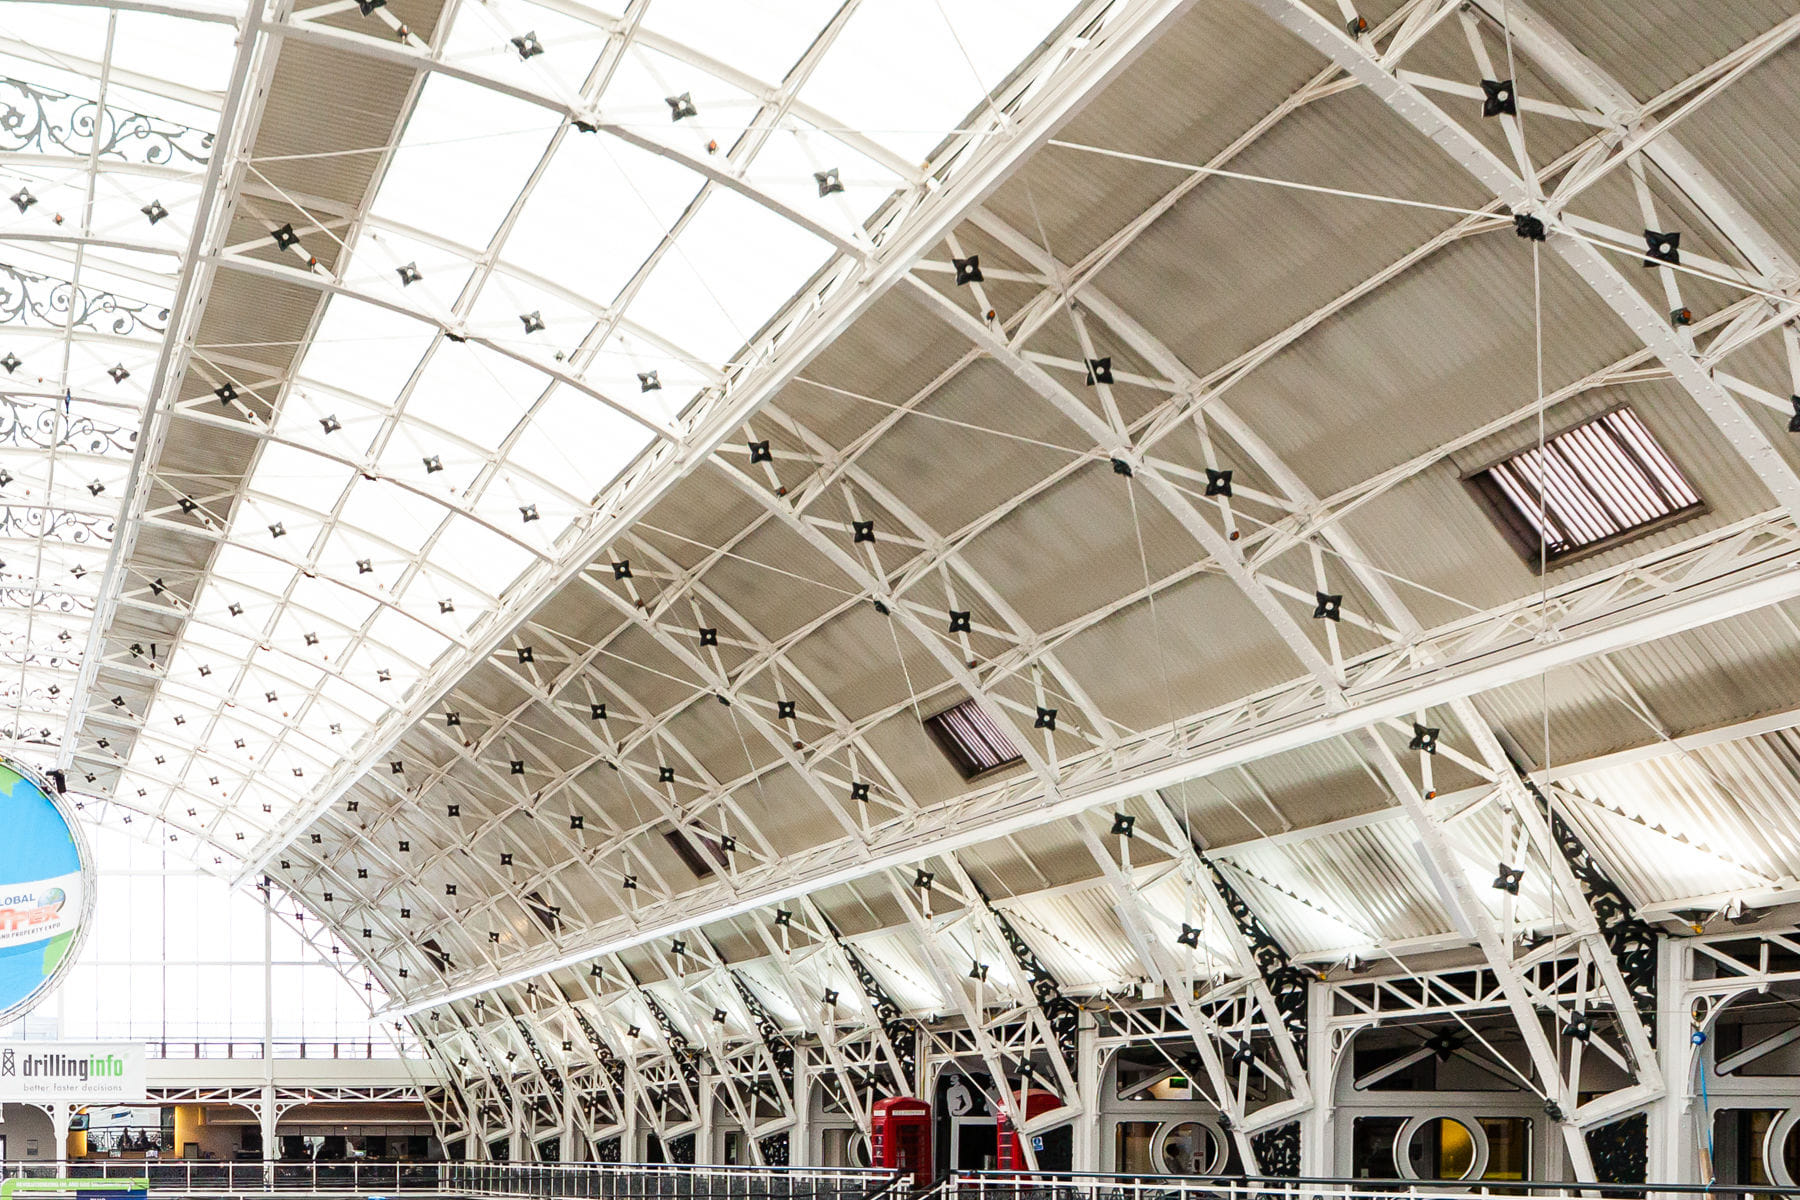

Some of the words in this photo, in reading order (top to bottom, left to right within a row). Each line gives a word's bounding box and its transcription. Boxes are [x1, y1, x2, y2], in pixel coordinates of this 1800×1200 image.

[11, 926, 44, 939] PROPERTY
[44, 921, 62, 932] EXPO
[23, 1054, 123, 1082] drillinginfo
[24, 1083, 50, 1092] better
[53, 1083, 78, 1092] faster
[82, 1083, 122, 1092] decisions
